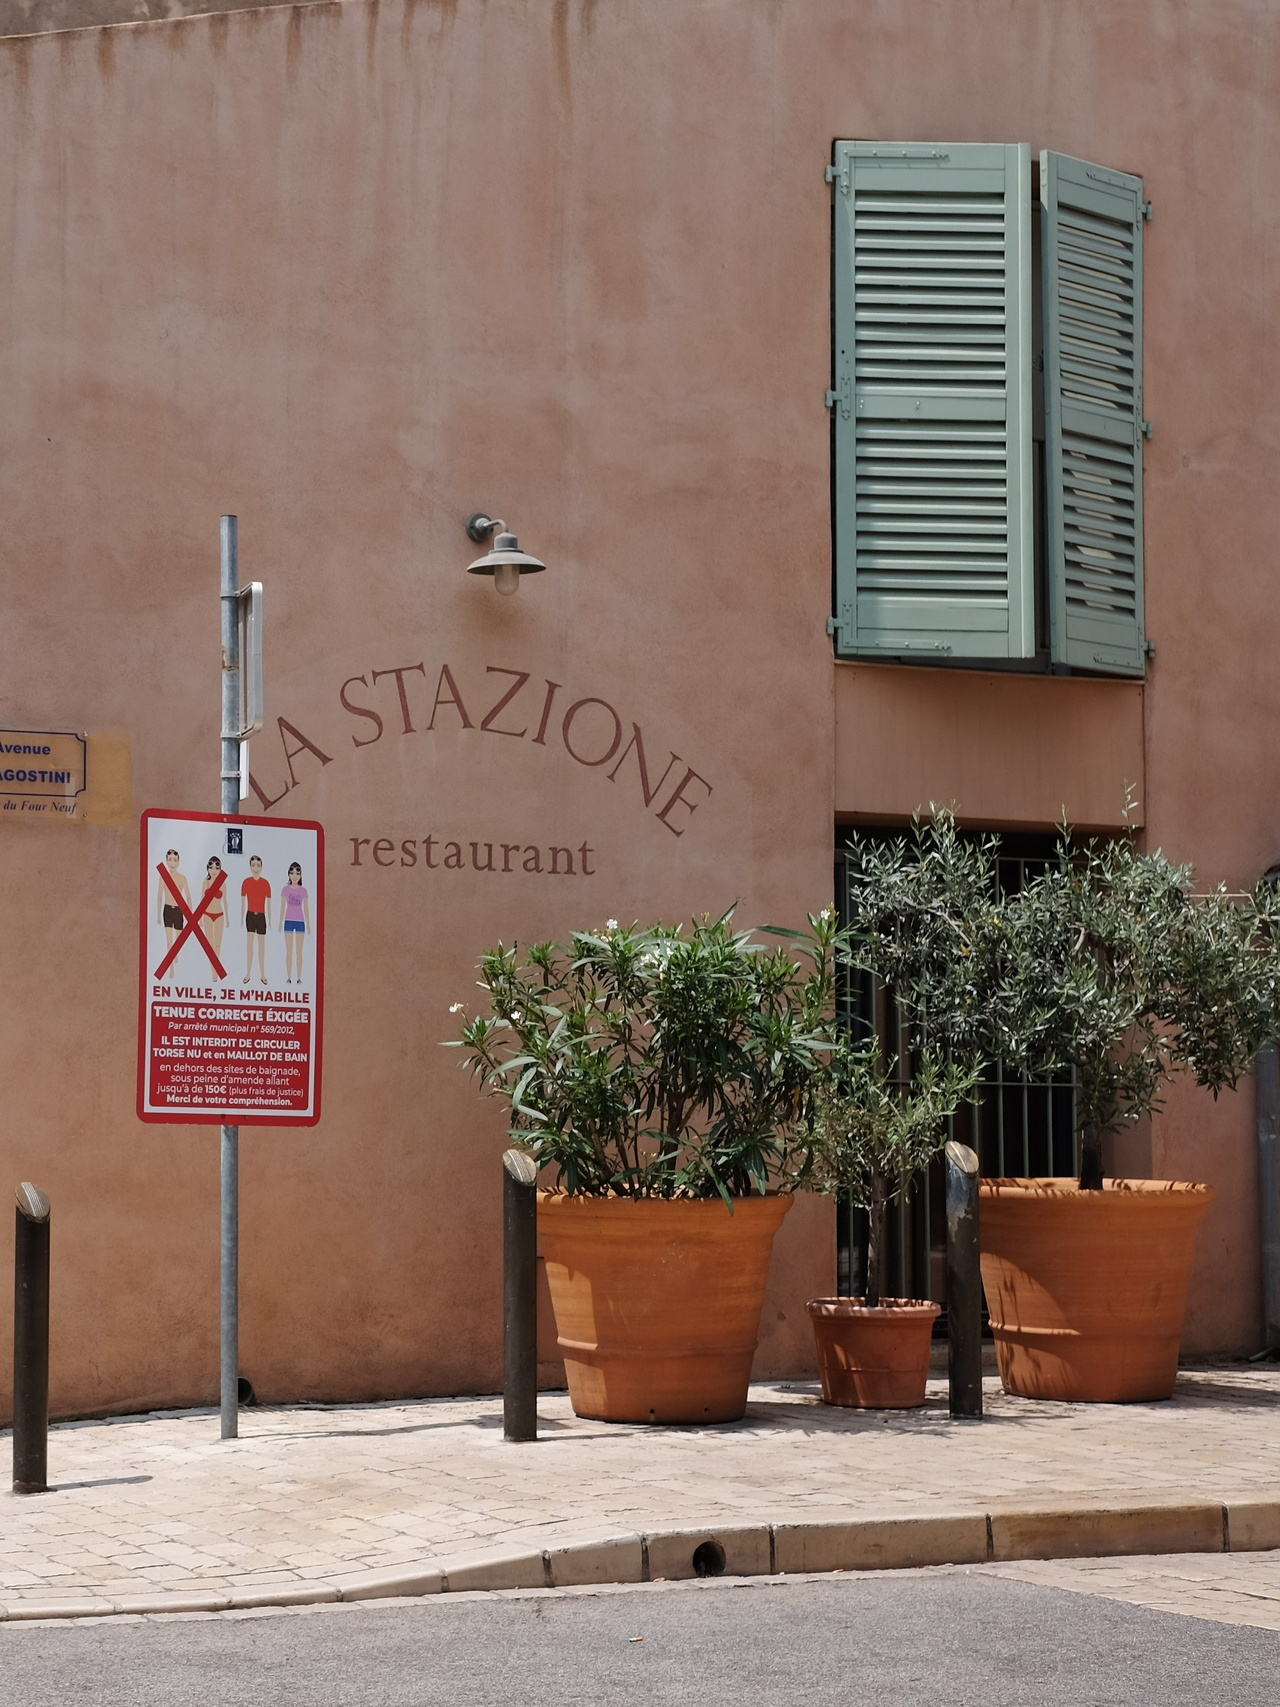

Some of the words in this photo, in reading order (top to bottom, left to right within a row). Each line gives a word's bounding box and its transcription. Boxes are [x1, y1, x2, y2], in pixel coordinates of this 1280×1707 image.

[248, 716, 334, 811] LA
[339, 662, 713, 838] STAZIONE
[3, 800, 17, 811] du
[21, 801, 47, 811] Four
[50, 802, 78, 814] Neuf
[349, 834, 596, 876] restaurant
[153, 986, 171, 997] EN
[175, 987, 216, 1001] VILLE,
[220, 989, 235, 1000] JE
[240, 990, 310, 1003] M'HABILLE
[154, 1006, 195, 1018] TENUE
[198, 1008, 263, 1021] CORRECTE
[266, 1008, 308, 1023] ÉXIGÉE
[168, 1021, 182, 1030] Par
[184, 1022, 208, 1031] arrêté
[209, 1023, 249, 1033] municipal
[161, 1036, 171, 1045] IL
[172, 1036, 190, 1045] EST
[192, 1037, 237, 1047] INTERDIT
[239, 1038, 252, 1048] DE
[254, 1039, 300, 1050] CIRCULER
[153, 1048, 185, 1057] TORSE
[187, 1049, 201, 1058] NU
[203, 1051, 212, 1059] et
[227, 1051, 268, 1060] MAILLOT
[270, 1052, 282, 1061] DE
[285, 1053, 308, 1062] BAIN
[160, 1064, 171, 1072] en
[173, 1063, 204, 1072] dehors
[206, 1064, 222, 1073] des
[224, 1064, 244, 1074] sites
[246, 1065, 257, 1074] de
[259, 1066, 300, 1077] baignade,
[193, 1074, 218, 1084] peine
[220, 1075, 264, 1085] d'amende
[266, 1076, 289, 1085] allant
[156, 1083, 189, 1095] jusqu'à
[191, 1084, 203, 1093] de
[205, 1085, 227, 1094] 150€
[229, 1087, 247, 1096] (plus
[249, 1087, 265, 1095] frais
[266, 1087, 276, 1095] de
[277, 1088, 304, 1097] justice)
[167, 1094, 190, 1103] Merci
[192, 1095, 203, 1103] de
[205, 1096, 227, 1104] votre
[228, 1097, 292, 1106] compréhension.
